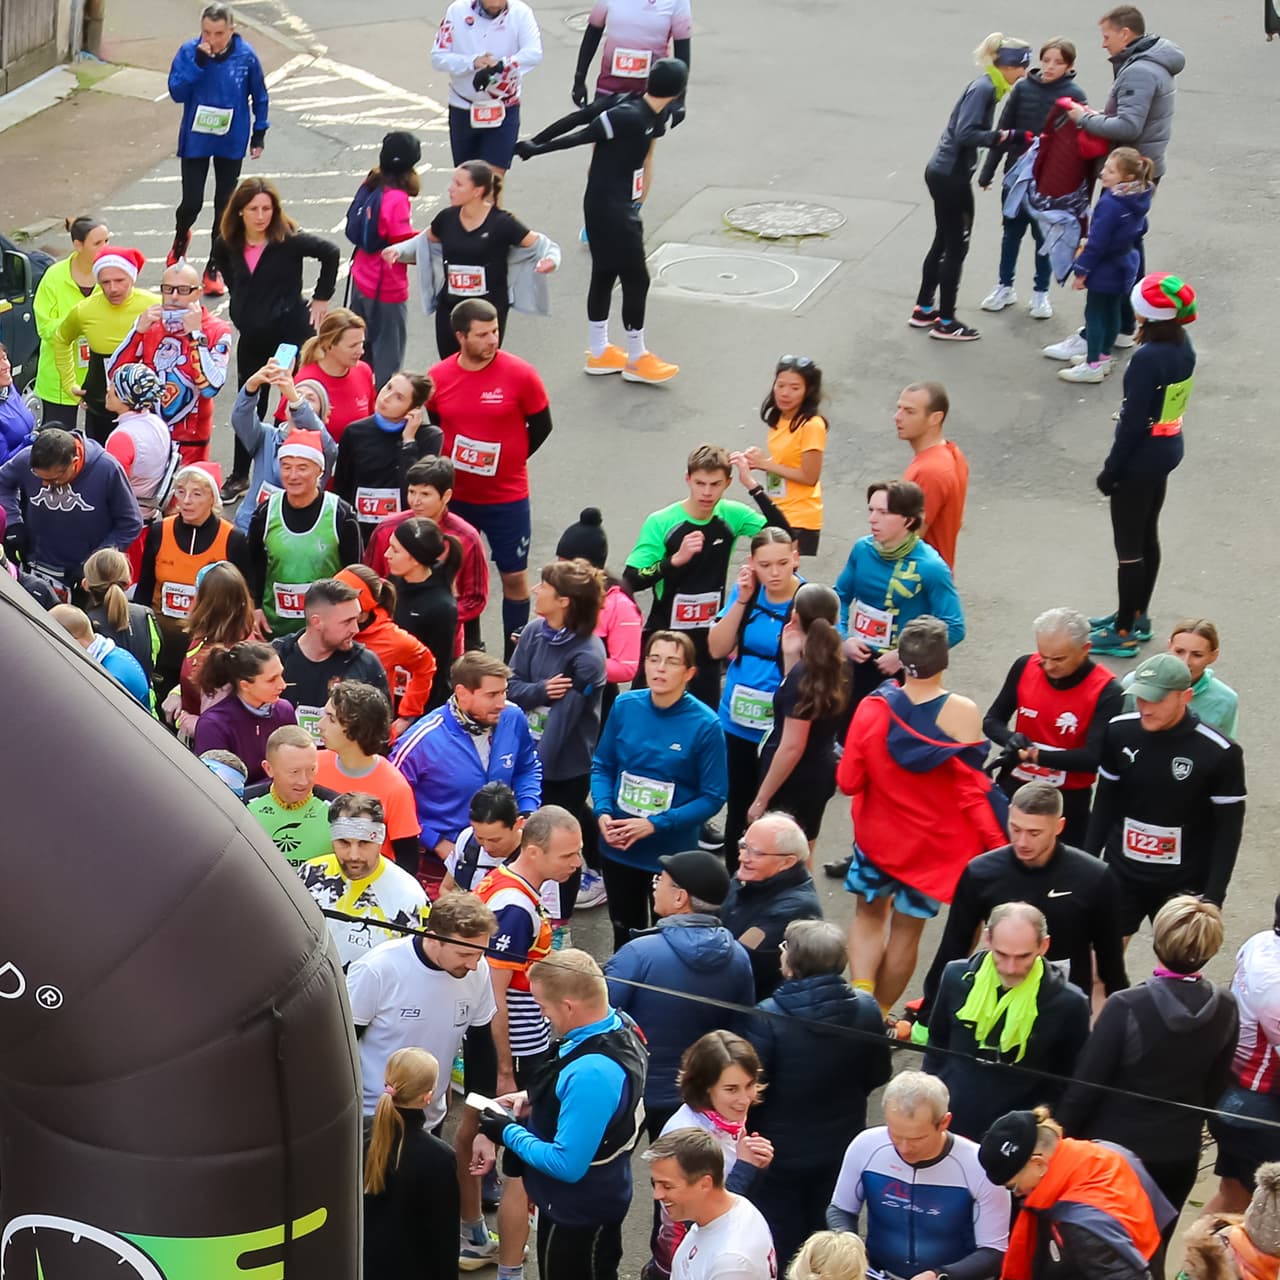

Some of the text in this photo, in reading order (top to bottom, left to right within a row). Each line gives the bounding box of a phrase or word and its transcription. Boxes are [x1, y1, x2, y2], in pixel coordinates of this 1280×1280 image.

[451, 274, 471, 287] 115
[460, 450, 478, 463] 43
[363, 498, 379, 513] 37
[172, 594, 191, 608] 90
[283, 595, 299, 608] 91
[683, 606, 700, 618] 31
[736, 701, 761, 718] 536
[1129, 833, 1159, 851] 122
[348, 933, 372, 949] ECA
